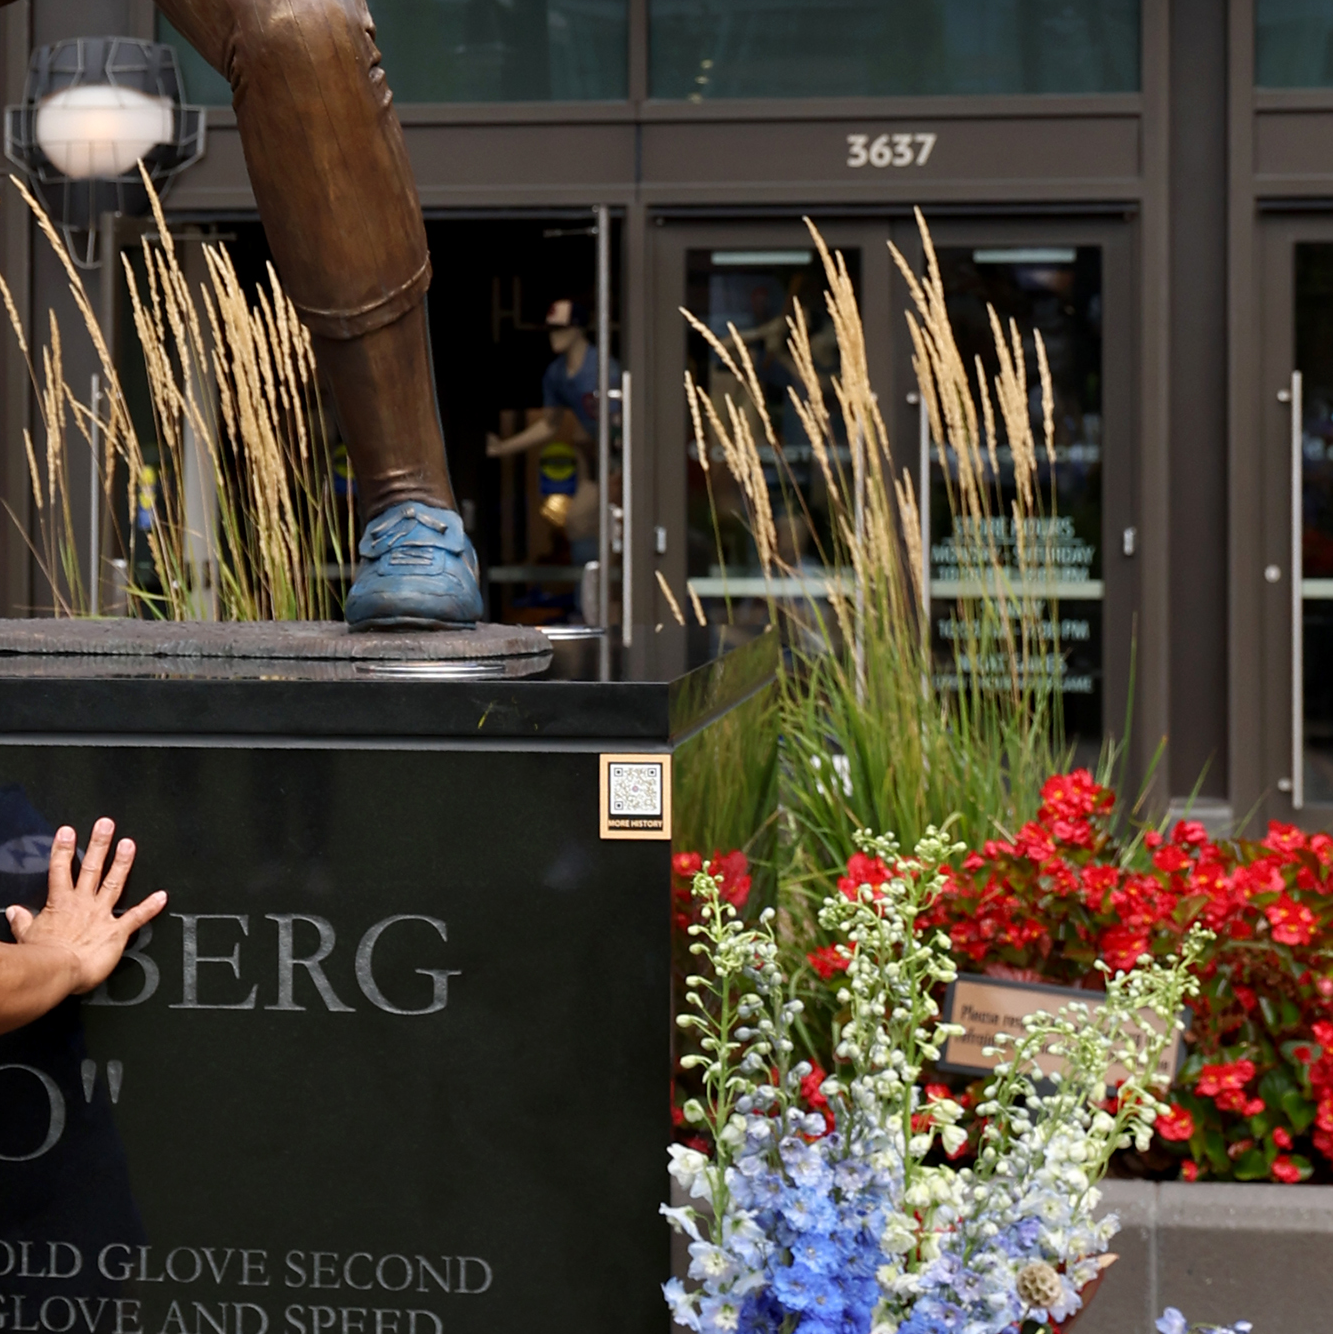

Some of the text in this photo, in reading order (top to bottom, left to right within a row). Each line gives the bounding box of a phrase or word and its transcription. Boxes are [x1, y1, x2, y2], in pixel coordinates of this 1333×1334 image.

[846, 132, 938, 168] 3637
[608, 819, 663, 828] MORE HISTORY
[97, 1243, 270, 1287] GLOVE
[284, 1249, 494, 1295] SECOND
